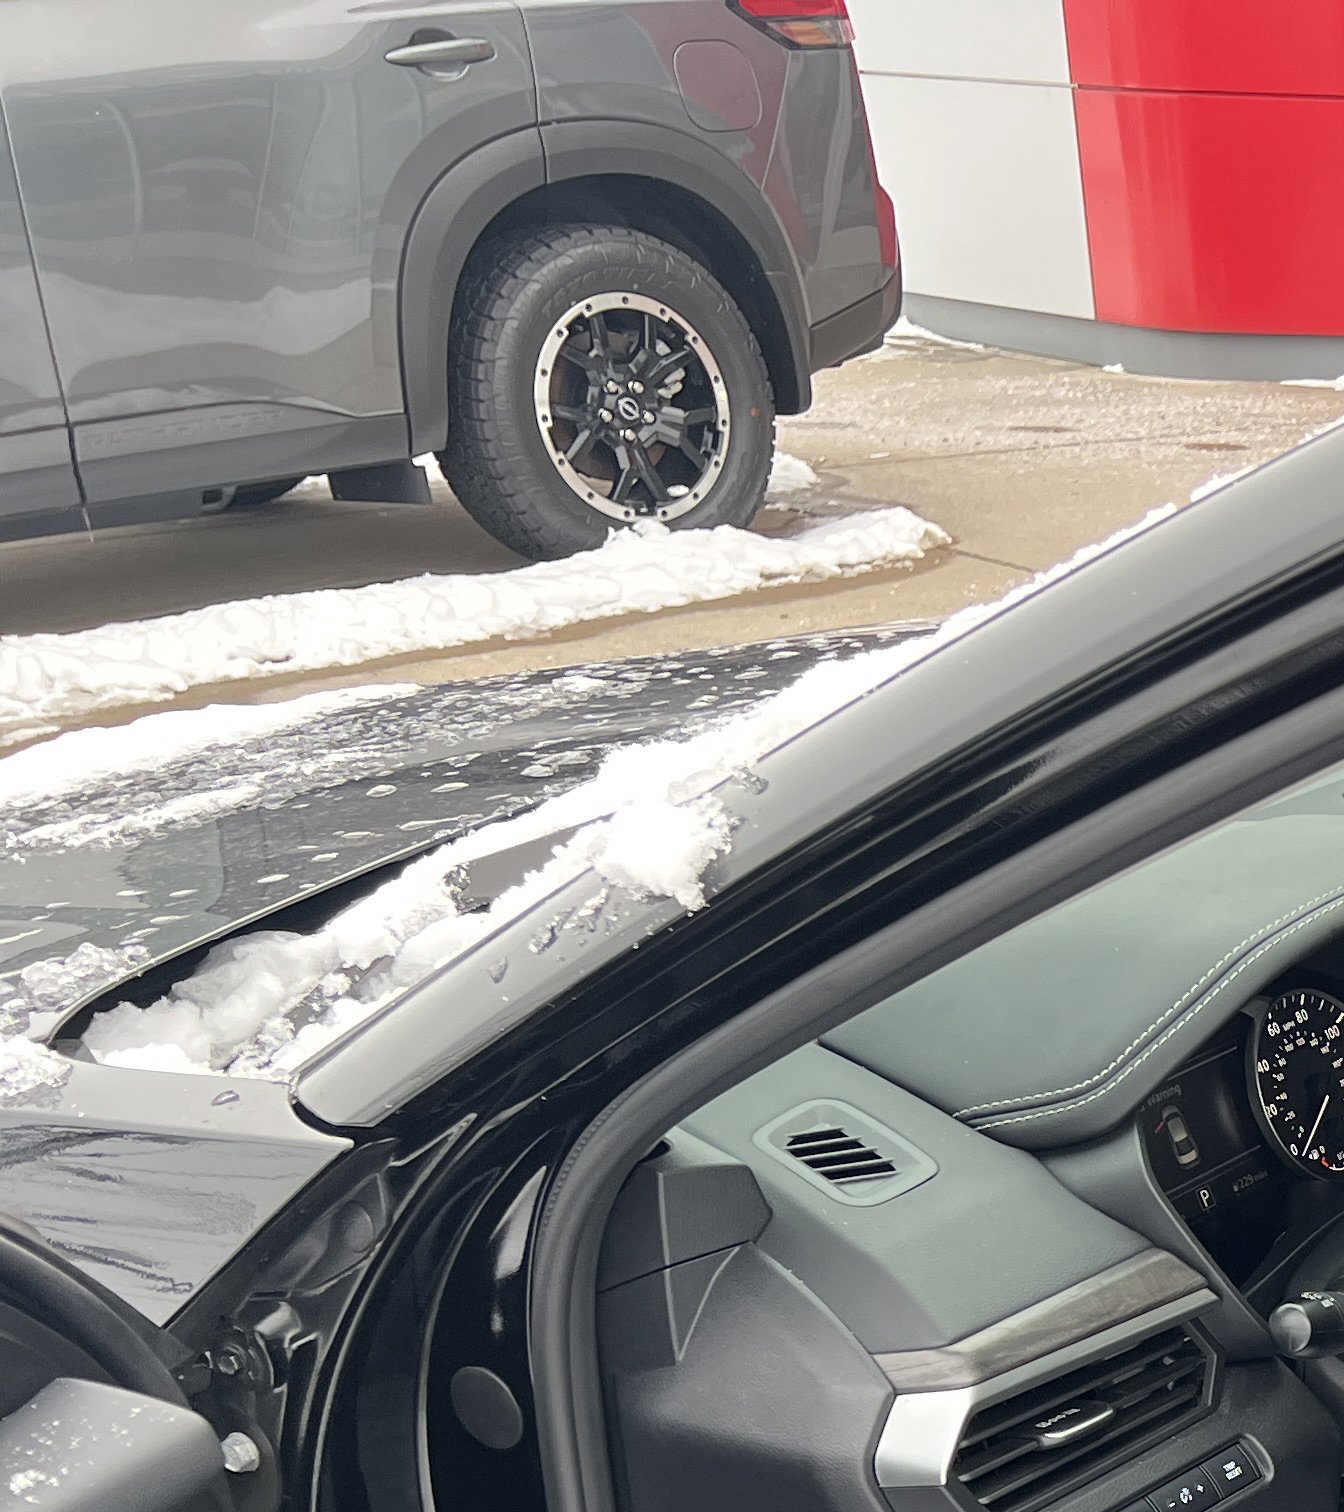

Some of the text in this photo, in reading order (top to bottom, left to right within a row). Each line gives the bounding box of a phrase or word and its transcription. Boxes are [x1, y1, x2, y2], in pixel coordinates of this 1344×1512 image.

[1294, 1008, 1309, 1023] 80
[1267, 1021, 1280, 1037] 60
[1323, 1024, 1340, 1040] 100
[1257, 1058, 1270, 1073] 40
[1146, 1083, 1182, 1107] Warning
[1264, 1103, 1278, 1119] 20
[1290, 1143, 1298, 1156] 0
[1199, 1189, 1210, 1208] P
